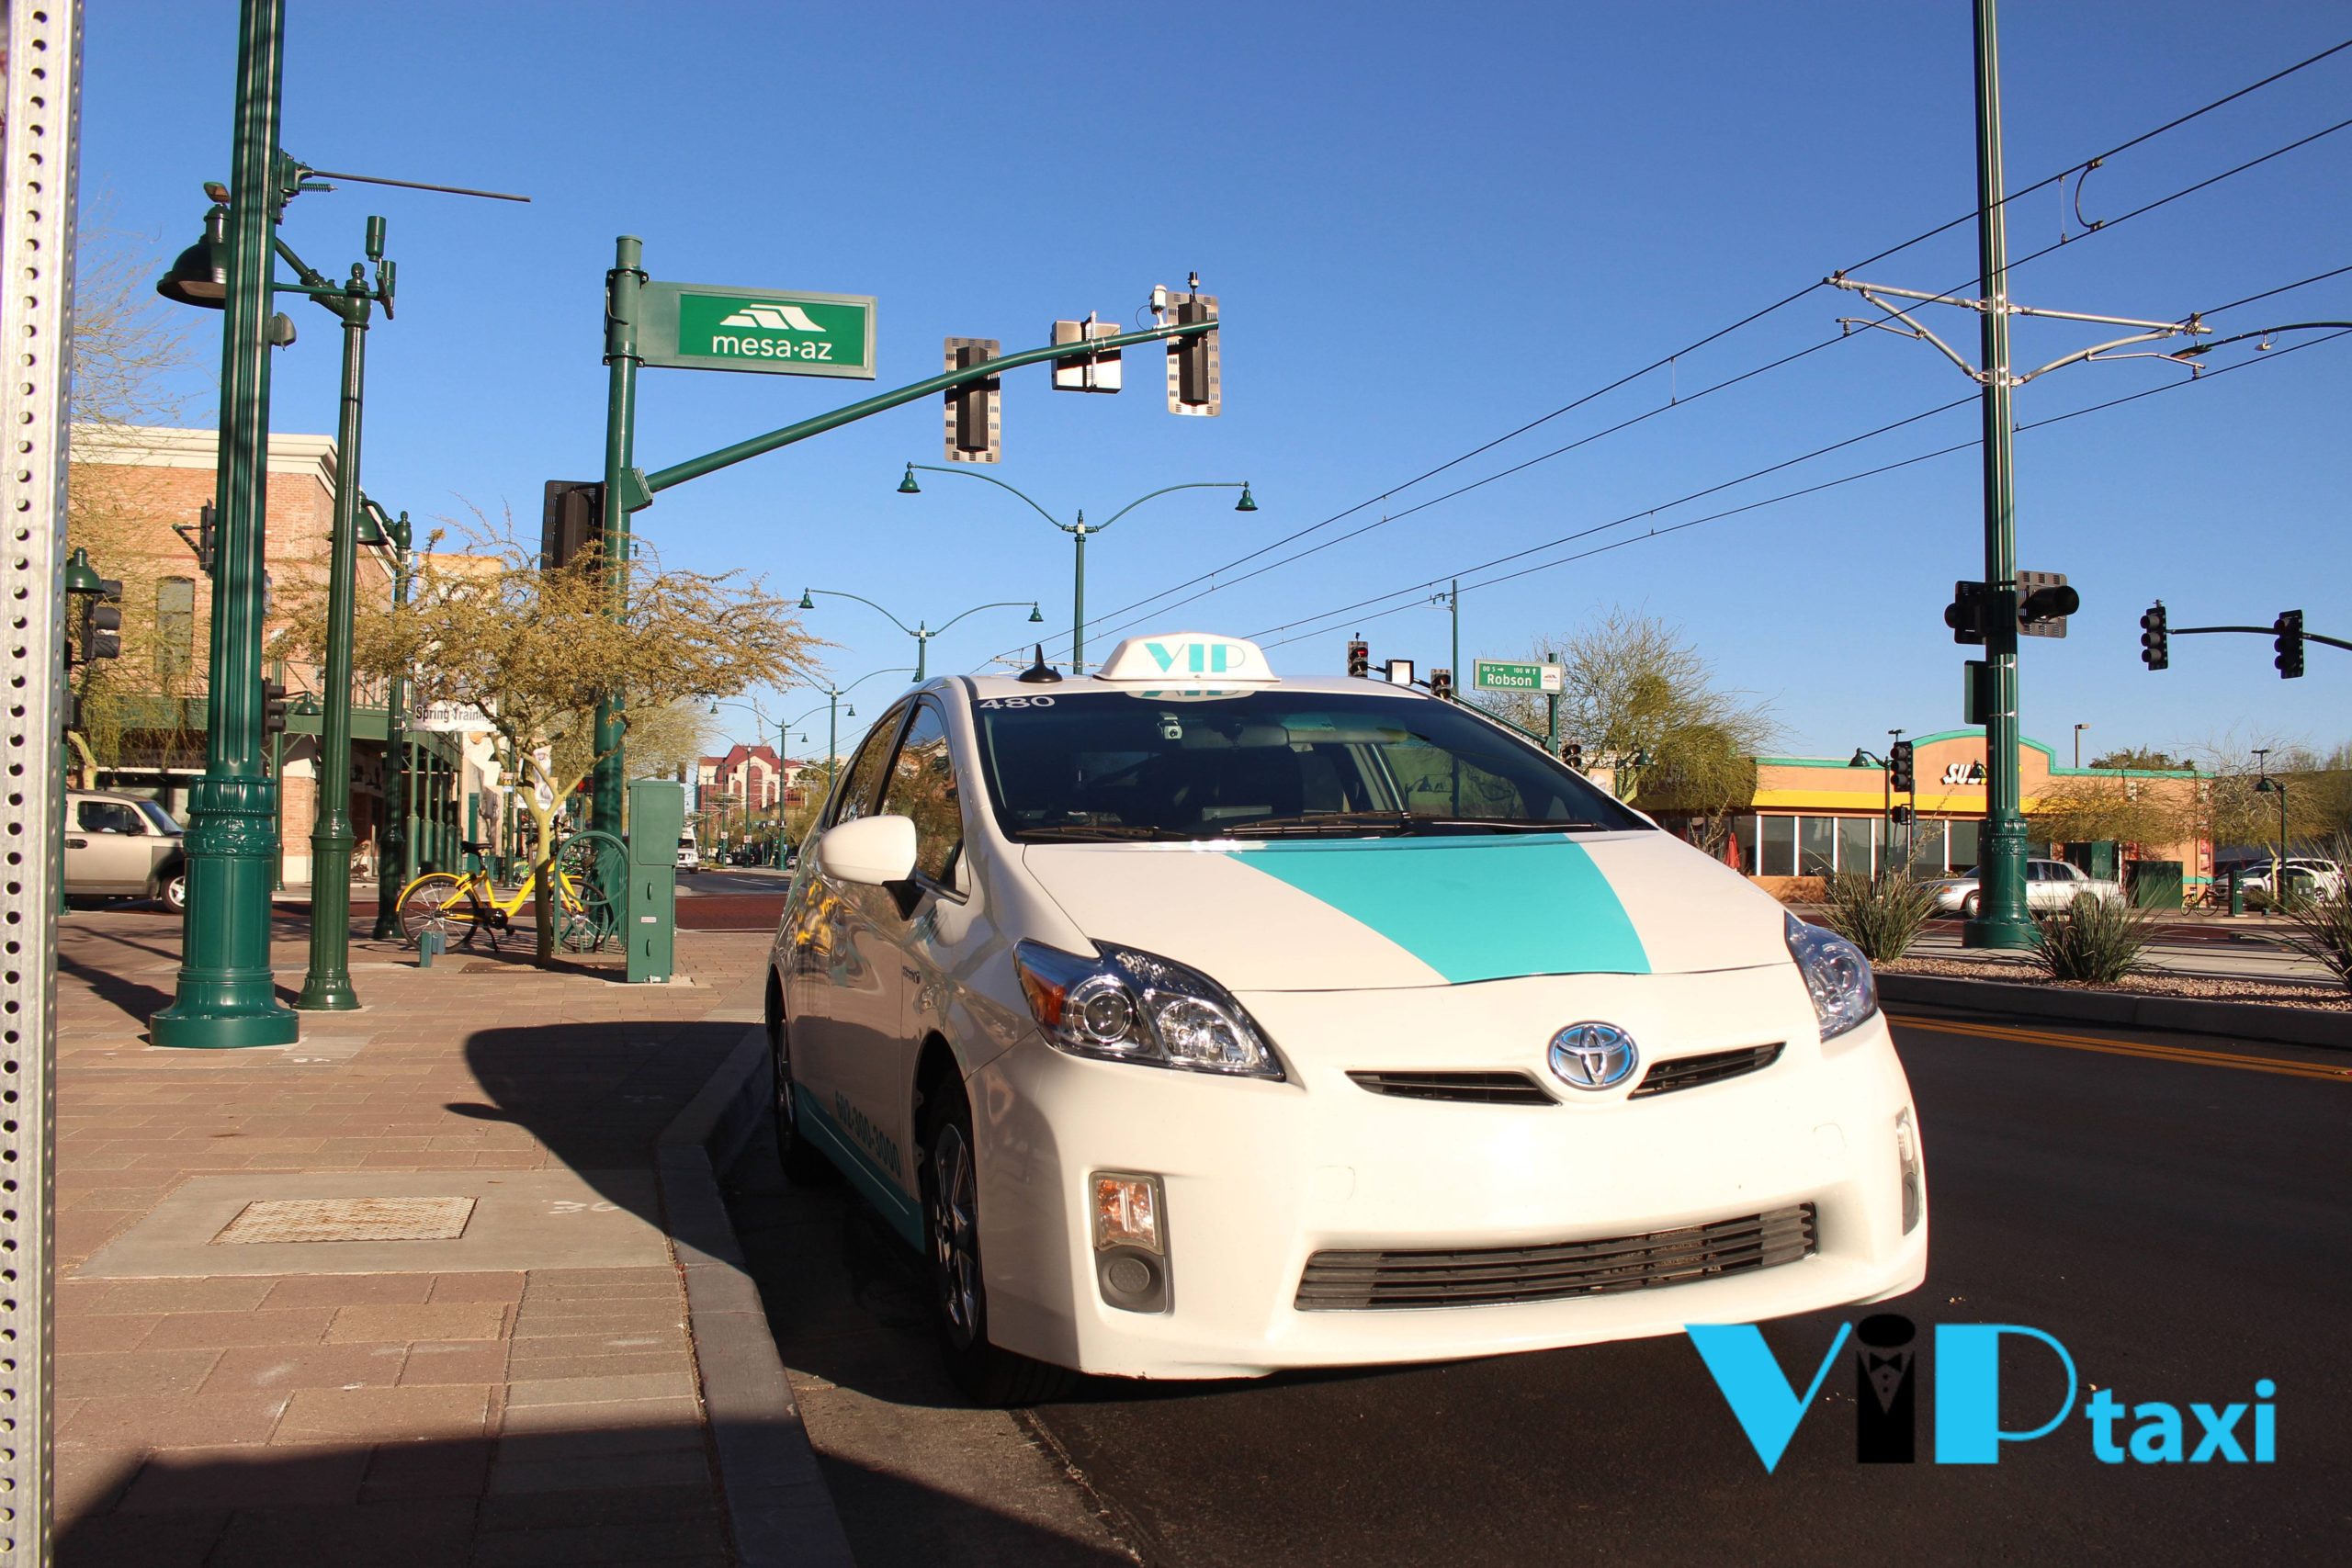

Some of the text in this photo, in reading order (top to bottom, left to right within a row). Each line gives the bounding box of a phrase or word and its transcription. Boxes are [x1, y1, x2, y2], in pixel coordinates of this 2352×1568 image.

[1144, 642, 1246, 673] VIP
[1487, 673, 1532, 686] Robson
[979, 695, 1056, 710] 480
[415, 705, 449, 723] Spring
